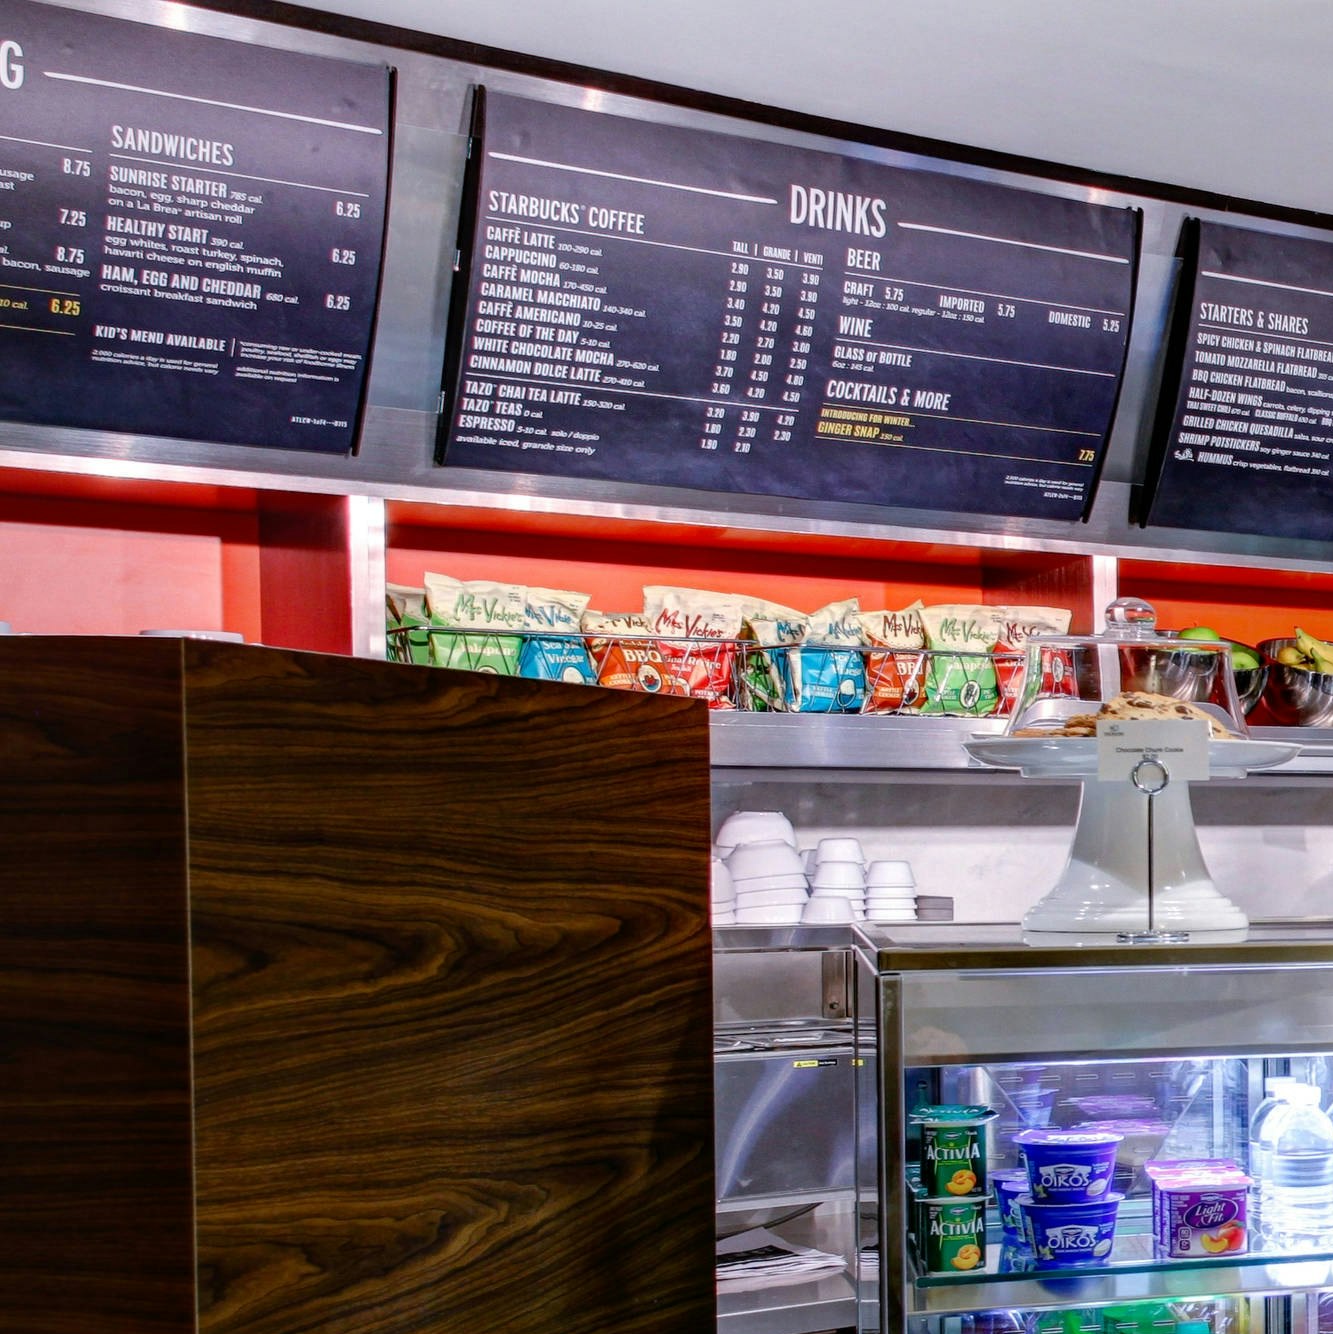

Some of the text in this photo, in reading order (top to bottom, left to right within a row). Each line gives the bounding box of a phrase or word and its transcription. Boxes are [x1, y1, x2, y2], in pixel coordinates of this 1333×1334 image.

[111, 125, 234, 166] SANDWICHES
[63, 158, 91, 177] 8.75
[108, 183, 256, 214] bacon, egg, sharp cheddar
[109, 165, 361, 219] SUNRISE STARTER 6.25
[60, 208, 87, 227] 7.25
[588, 206, 645, 235] COFFEE
[790, 184, 887, 238] DRINKS
[106, 215, 356, 265] HEALTHY START 6.25
[57, 246, 85, 264] 8.75
[485, 244, 557, 268] CAPPUCCINO
[523, 231, 556, 250] LATTE
[731, 262, 749, 275] 2.90
[766, 267, 784, 281] 3.50
[802, 273, 820, 286] 3.90
[732, 240, 824, 265] TALL GRANDE VENTI
[847, 247, 881, 271] BEER
[102, 264, 351, 311] HAM, EGG AND CHEDDAR 6.25
[519, 268, 561, 288] MOCHA
[50, 299, 81, 316] 6.25
[100, 283, 257, 310] croissant breakfast sandwich
[480, 281, 601, 311] CARAMEL MACCHIATO
[843, 280, 1120, 333] CRAFT 5.75 IMPORTED 5.75 DOMESTIC 5.25
[514, 305, 581, 327] AMERICANO
[839, 315, 874, 338] WINE
[1199, 302, 1309, 335] STARTERS & SHARES
[95, 325, 226, 352] KID'S MENU AVAILABLE
[475, 318, 580, 344] COFFEE OF THE DAY
[473, 336, 614, 366] WHITE CHOCOLATE MOCHA
[834, 345, 913, 368] GLASS or BOTTLE
[1196, 332, 1221, 347] SPICY
[1221, 335, 1255, 352] CHICKEN
[1255, 340, 1262, 353] &
[1262, 341, 1296, 358] SPINACH
[470, 354, 602, 383] CINNAMON DOLCE LATTE
[1195, 350, 1226, 366] TOMATO
[1226, 355, 1275, 373] MOZZARELLA
[1276, 362, 1318, 379] FLATBREAD
[1191, 368, 1209, 384] BBQ
[1209, 371, 1244, 387] CHICKEN
[1243, 375, 1286, 392] FLATBREAD
[498, 384, 527, 400] CHAI
[528, 387, 547, 402] TEA
[549, 390, 582, 406] LATTE
[826, 379, 952, 411] COCKTAILS & MORE
[495, 401, 523, 416] TEAS
[820, 408, 869, 422] INTRODUCING
[868, 413, 884, 424] FOR
[458, 414, 516, 433] ESPRESSO
[817, 421, 853, 436] GINGER
[853, 424, 880, 439] SNAP
[1182, 415, 1215, 429] GRILLED
[1215, 418, 1249, 433] CHICKEN
[1249, 422, 1294, 439] QUESADILLA
[1197, 451, 1234, 466] HUMMUS
[927, 1143, 981, 1160] ACTIVIA
[1195, 1202, 1226, 1217] Light
[930, 1217, 984, 1236] ACTIVIA
